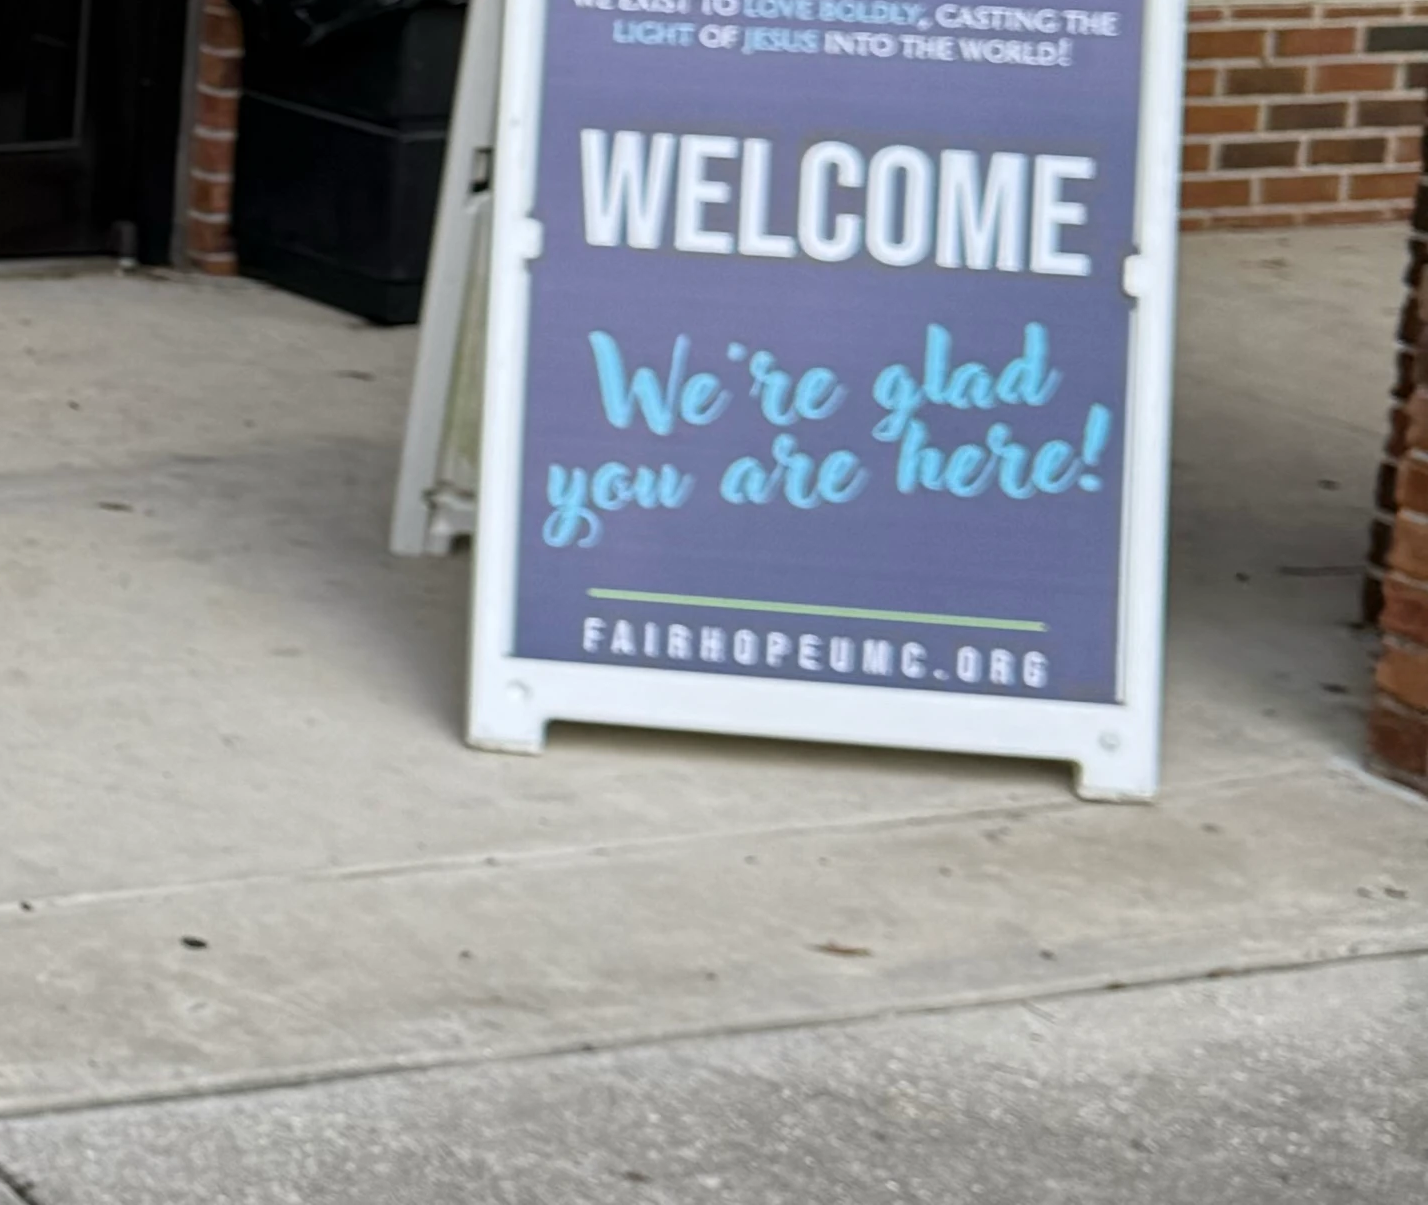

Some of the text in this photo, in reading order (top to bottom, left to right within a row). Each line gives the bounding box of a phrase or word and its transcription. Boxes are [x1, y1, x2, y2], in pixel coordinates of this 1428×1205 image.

[612, 18, 1074, 68] LIGHT OF JESUS INTO THE WORLD!
[934, 2, 1062, 35] CASTING
[1062, 9, 1122, 38] THE
[579, 127, 1097, 278] WELCOME
[587, 321, 1063, 443] We're glad
[543, 402, 1114, 549] you are here!
[581, 615, 1051, 690] FAIRHOPEUMC.ORG
